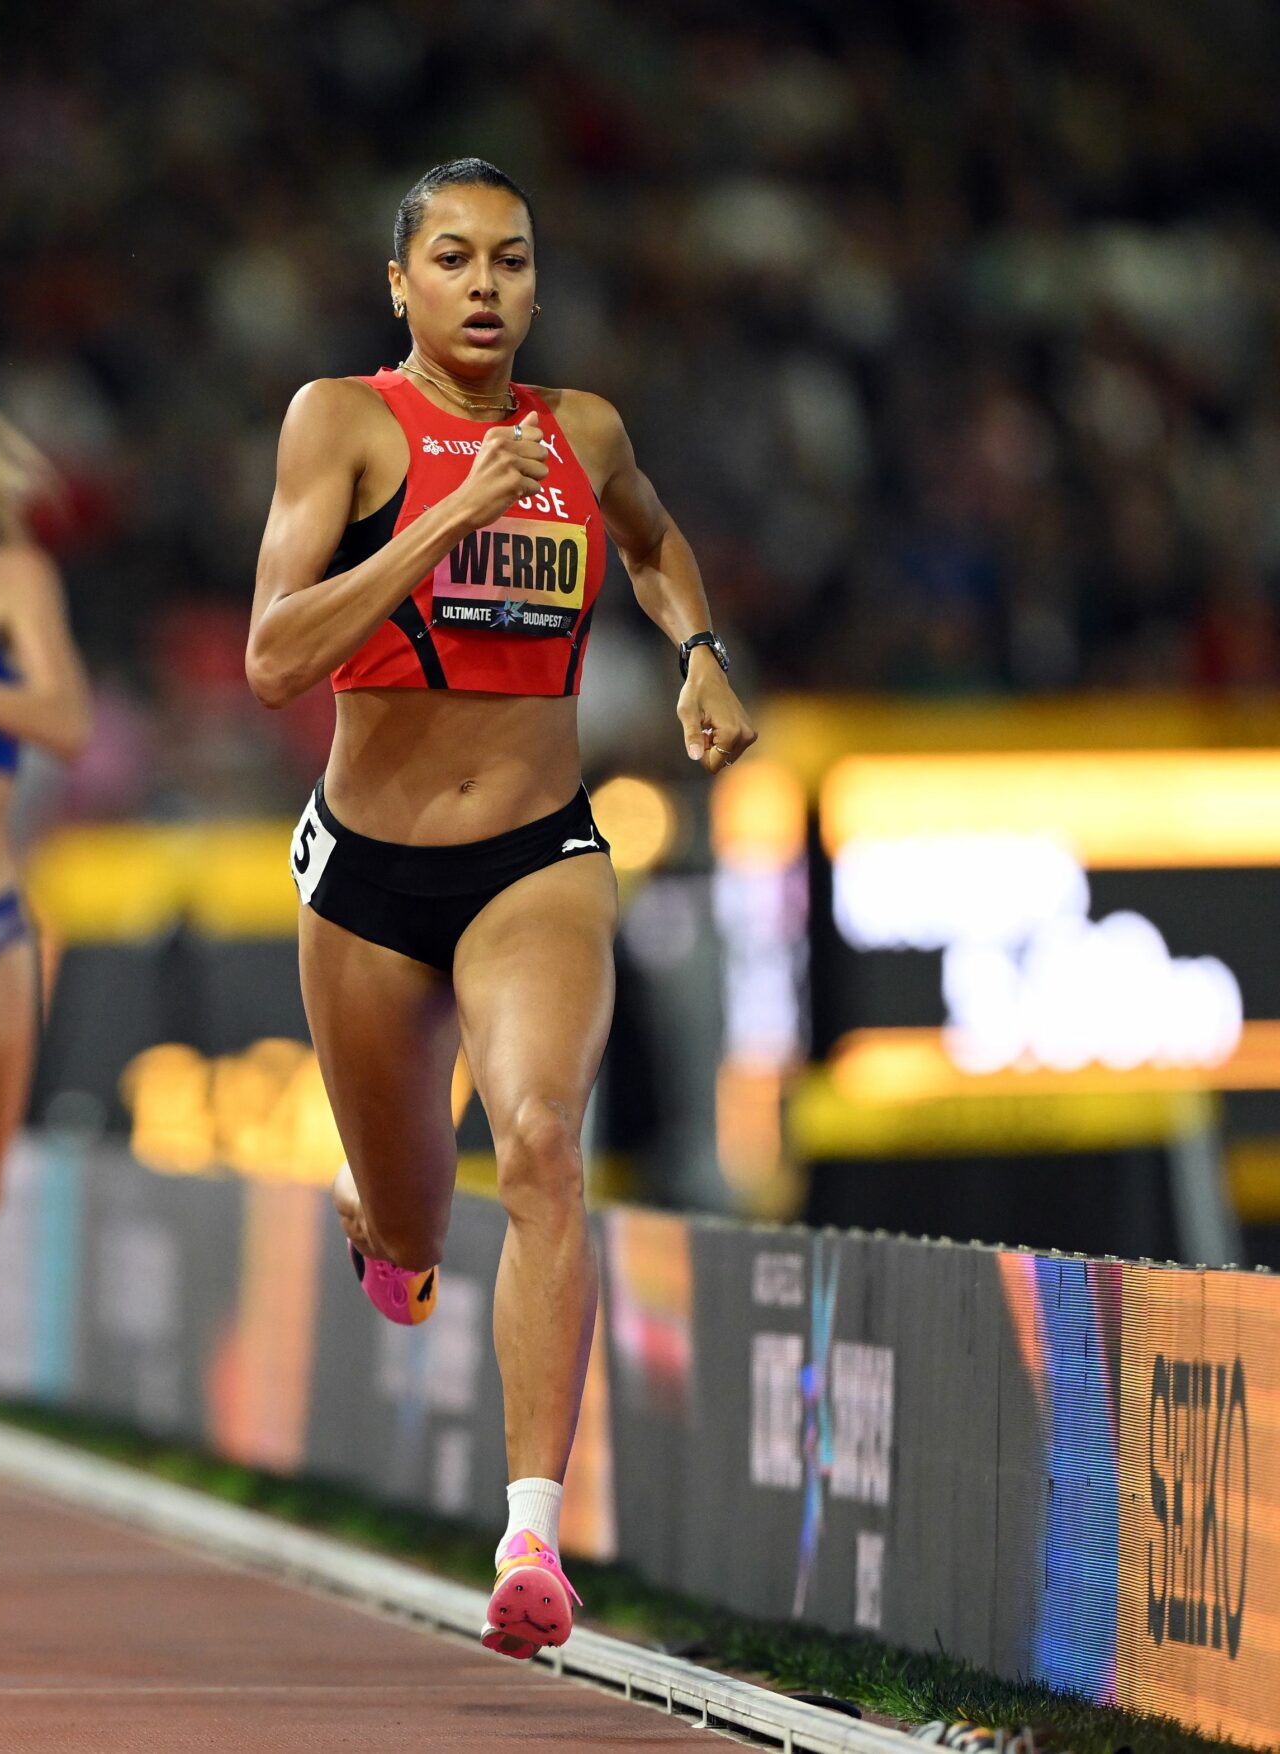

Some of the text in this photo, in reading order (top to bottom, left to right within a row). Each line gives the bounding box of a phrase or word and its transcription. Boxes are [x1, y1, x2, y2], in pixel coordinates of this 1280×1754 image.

[444, 440, 483, 456] UBS
[449, 531, 579, 595] WERRO
[442, 605, 492, 622] ULTIMATE
[523, 611, 563, 628] BUDAPEST
[294, 818, 317, 874] 5
[1148, 1353, 1249, 1660] SEIKO
